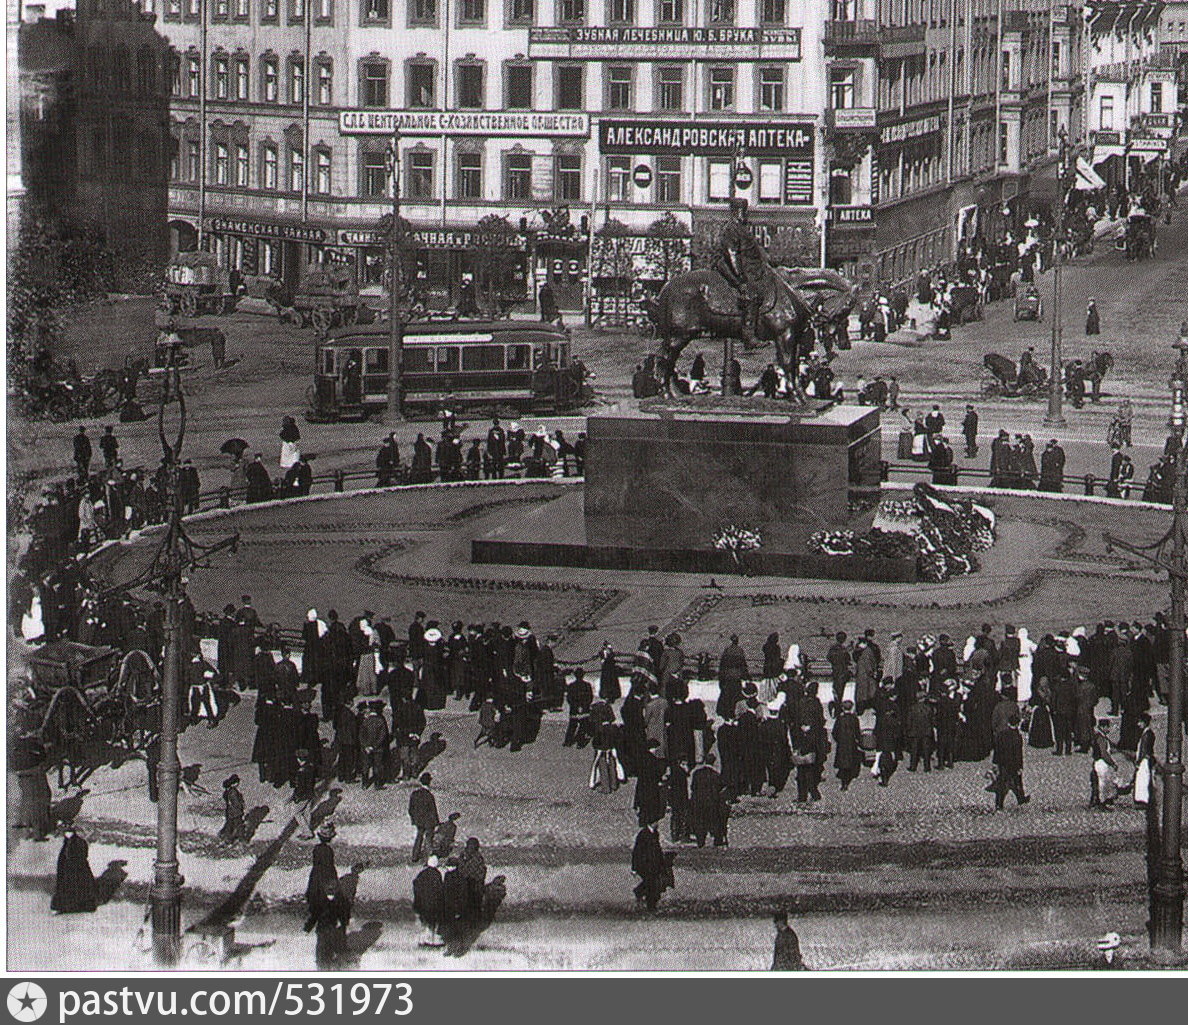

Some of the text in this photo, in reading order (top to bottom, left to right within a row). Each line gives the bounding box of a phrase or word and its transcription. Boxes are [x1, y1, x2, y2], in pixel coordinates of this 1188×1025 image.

[576, 29, 619, 41] ЗУБНАЯ
[623, 29, 689, 42] ЛЕЧЕБНИЦА
[720, 29, 755, 42] БРУКА
[368, 113, 437, 129] ЦЕНТРАЛЬНОЕ
[532, 115, 584, 131] ОБЩЕСТВО
[607, 127, 805, 148] АЛЕКСАНДРОВСКАЯ АПТЕКА
[840, 210, 872, 222] АПТЕКА
